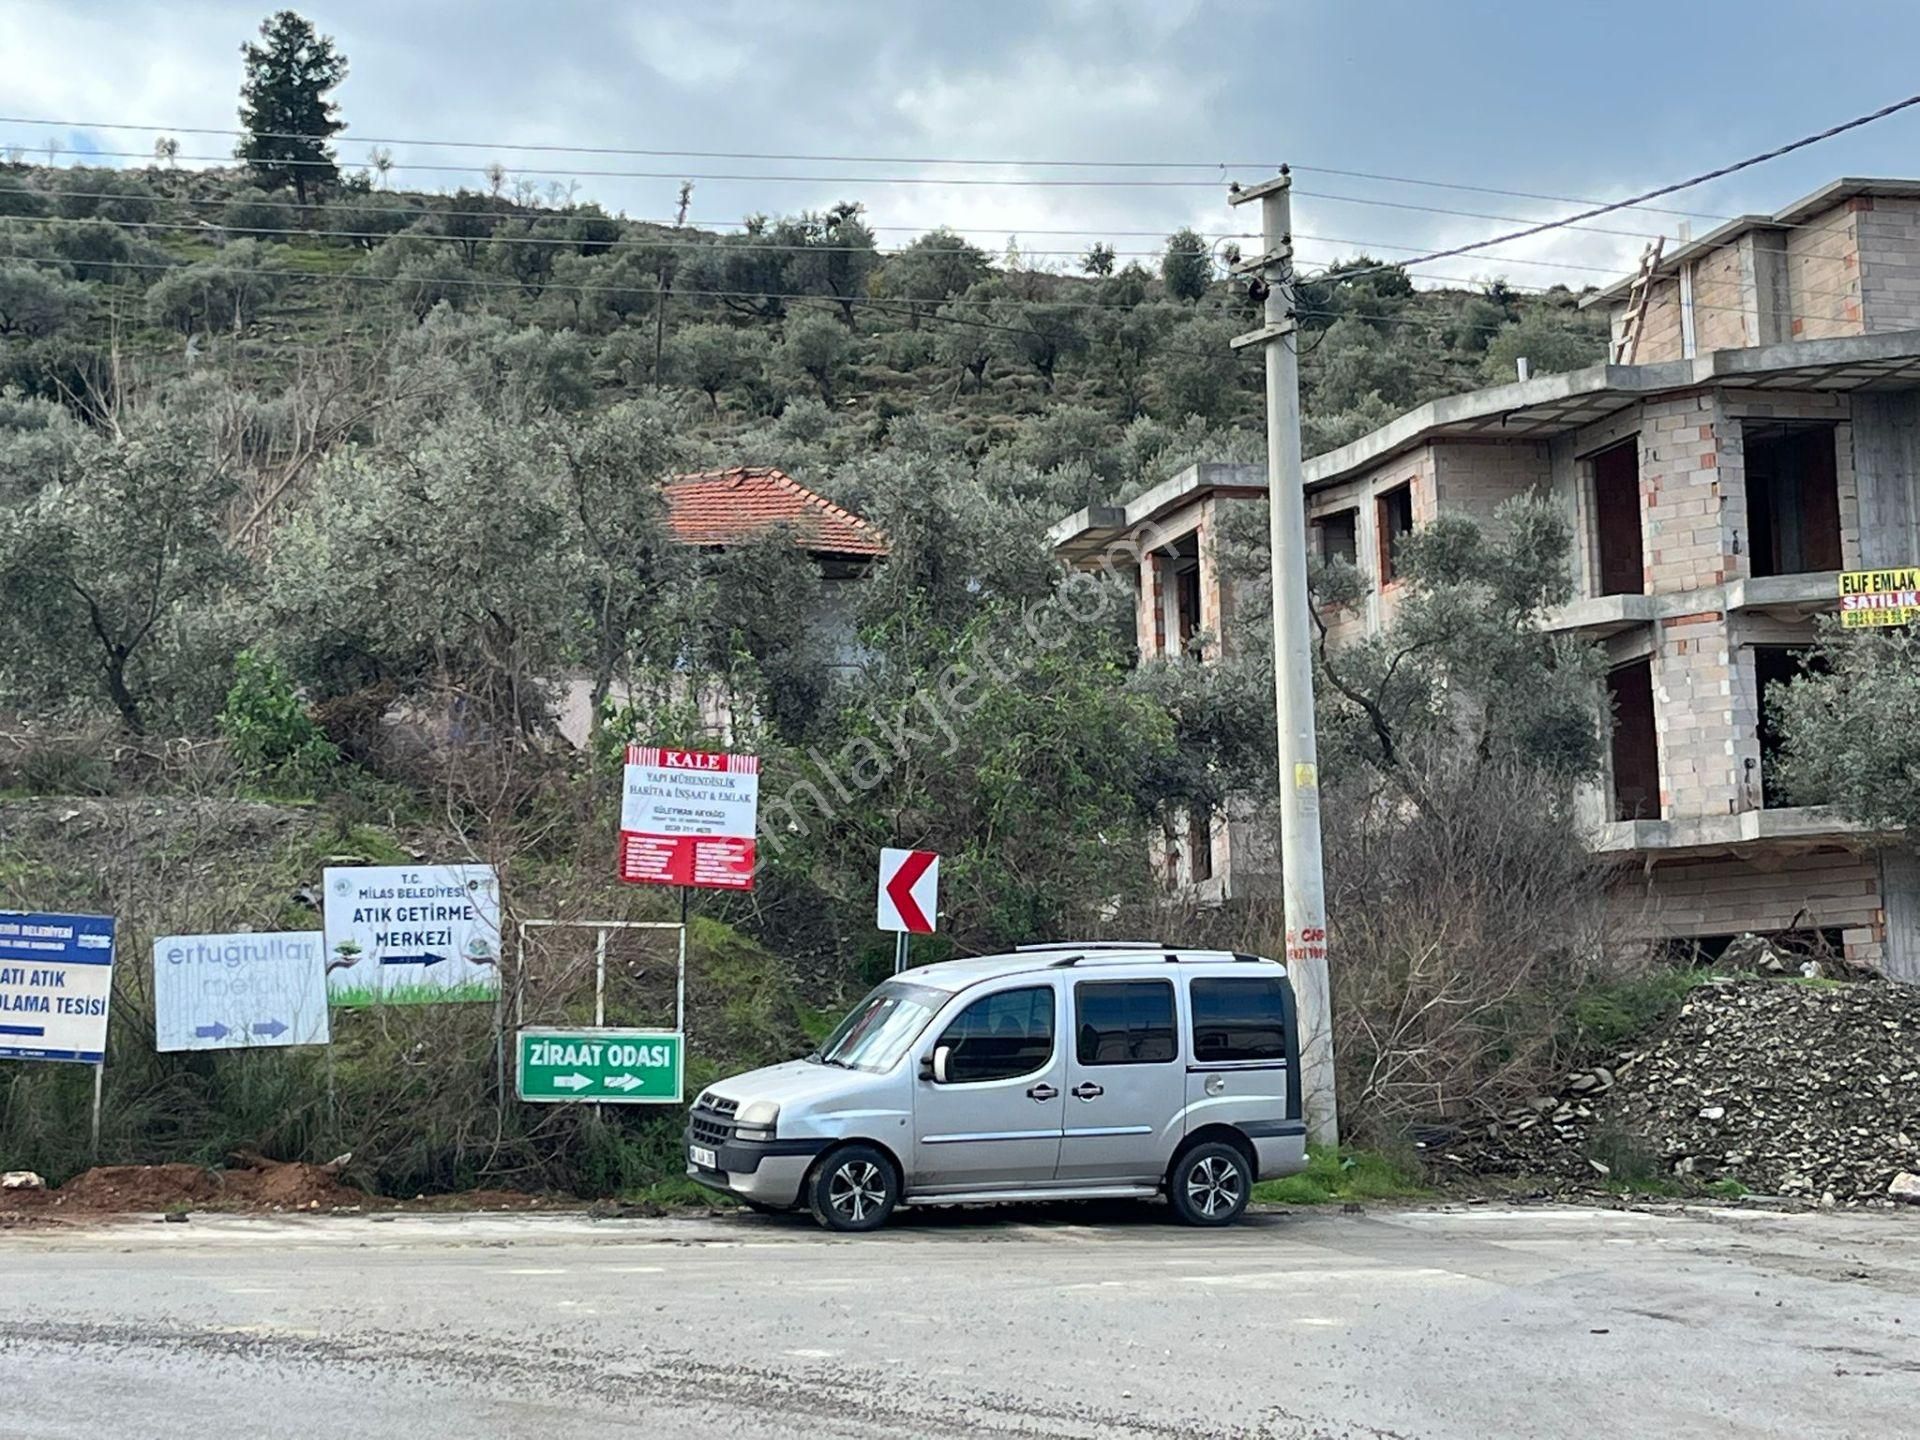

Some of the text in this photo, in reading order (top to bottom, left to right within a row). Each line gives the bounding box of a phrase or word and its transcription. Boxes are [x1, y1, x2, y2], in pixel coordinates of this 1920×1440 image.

[1872, 571, 1917, 591] EMLAK
[1843, 592, 1919, 610] SATILIK
[665, 751, 721, 770] KALE
[359, 885, 466, 900] MİLAS BELEDİYESİ
[353, 903, 474, 923] ATIK GETİRME
[376, 926, 452, 947] MERKEZİ
[167, 938, 314, 968] ertuğrullar
[30, 970, 67, 988] ATIK
[56, 995, 106, 1016] TESİSİ
[529, 1040, 671, 1068] ZİRAAT ODASI
